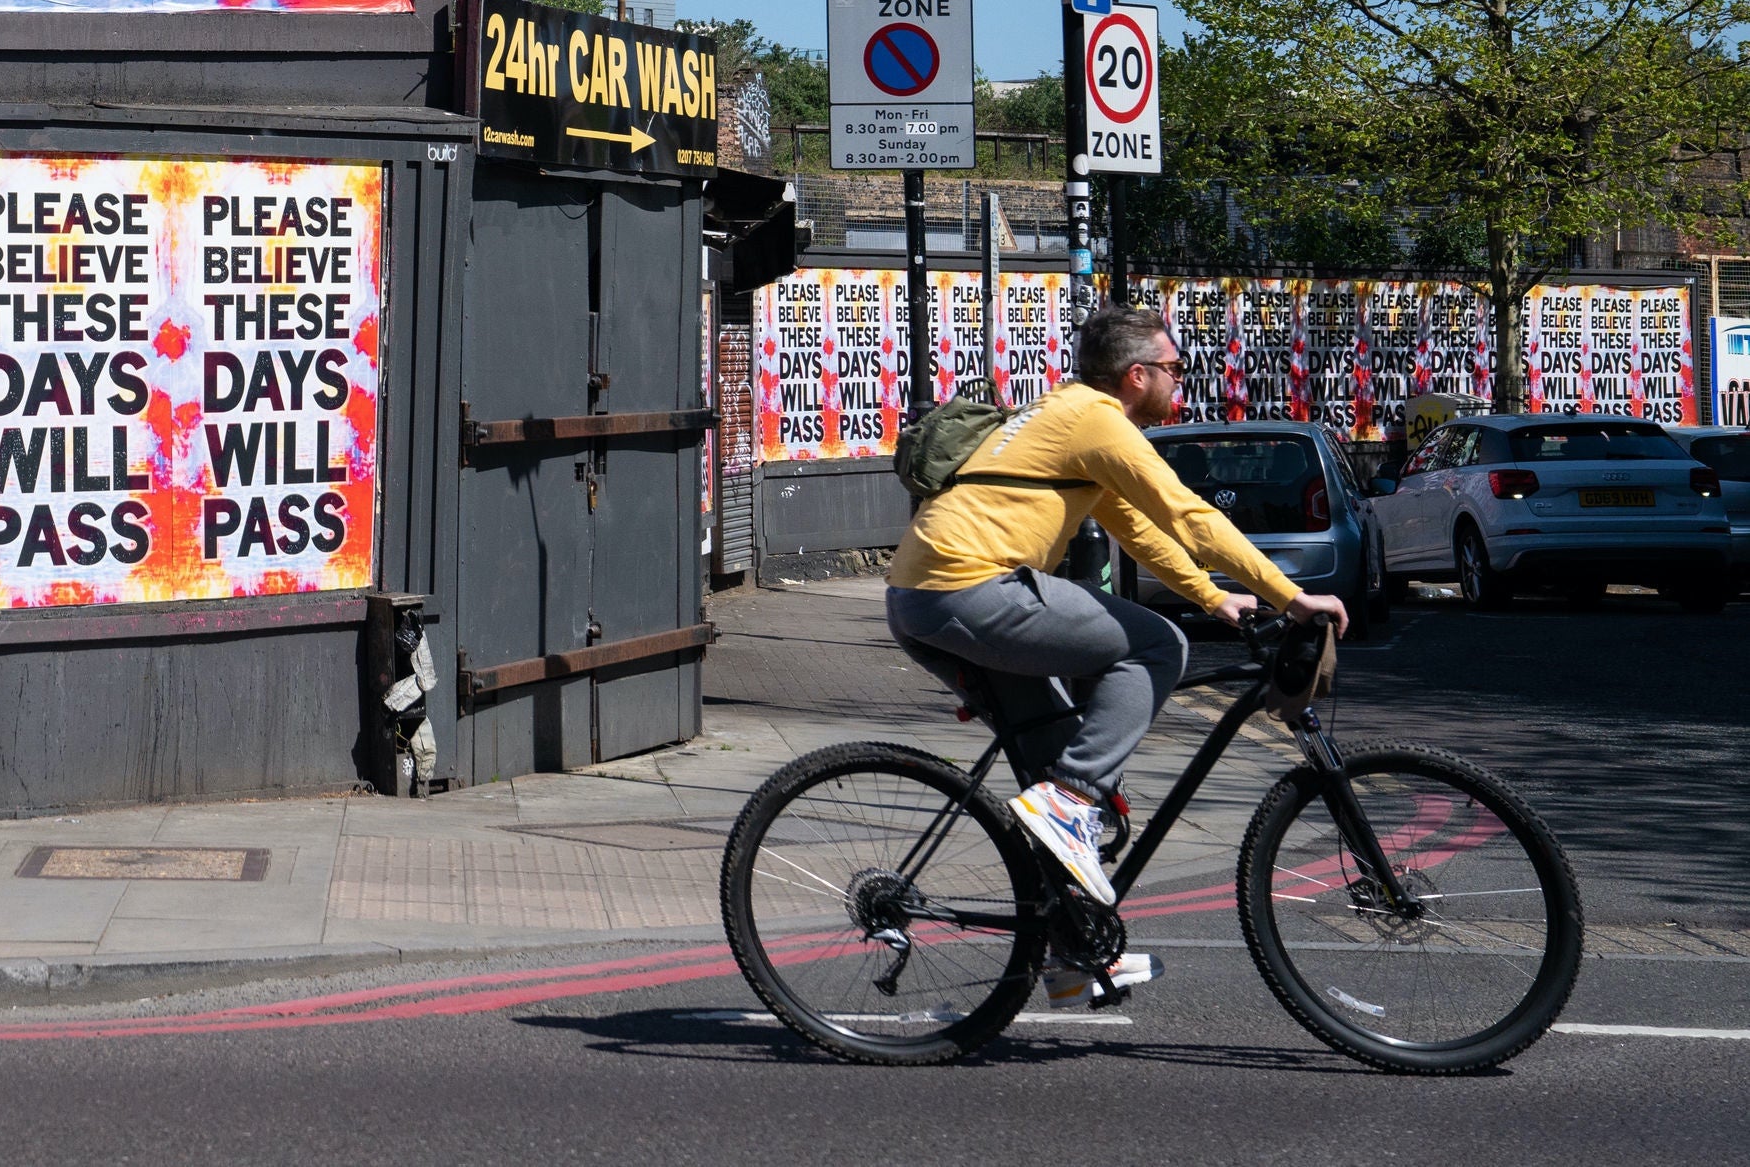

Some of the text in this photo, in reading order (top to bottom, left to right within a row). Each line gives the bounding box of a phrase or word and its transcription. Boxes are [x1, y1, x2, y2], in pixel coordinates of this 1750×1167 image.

[878, 0, 950, 17] ZONE
[485, 13, 560, 98] 24hr
[568, 29, 631, 109] CAR
[636, 41, 716, 120] WASH
[1097, 44, 1143, 90] 20
[845, 123, 877, 135] 8.30
[878, 125, 897, 134] am
[907, 123, 936, 134] 7.00
[939, 125, 959, 135] pm
[427, 143, 457, 162] build
[878, 139, 927, 151] Sunday
[1092, 131, 1153, 160] ZONE
[845, 153, 877, 164] 8.30
[879, 155, 898, 164] am
[906, 153, 938, 164] 2.00
[940, 155, 960, 165] pm
[204, 196, 351, 237] PLEASE
[204, 247, 351, 283] BELIEVE
[778, 284, 820, 302] PLEASE
[836, 284, 879, 302] PLEASE
[1008, 288, 1045, 303] PLEASE
[1129, 290, 1160, 305] EASE
[1178, 291, 1225, 307] PLEASE
[1243, 292, 1290, 307] PLEASE
[1308, 293, 1355, 308] PLEASE
[1373, 294, 1418, 309] PLEASE
[1433, 295, 1475, 310] PLEASE
[1542, 297, 1581, 311] PLEASE
[1592, 298, 1632, 312] PLEASE
[1641, 298, 1680, 312] PLEASE
[205, 294, 350, 340] THESE
[779, 306, 821, 322] BELIEVE
[837, 307, 879, 322] BELIEVE
[954, 307, 981, 322] BELIE
[1008, 308, 1045, 322] BELIEVE
[1178, 311, 1226, 325] BELIEVE
[1244, 312, 1290, 325] BELIEVE
[1308, 312, 1355, 326] BELIEVE
[1372, 313, 1417, 326] BELIEVE
[1432, 313, 1475, 327] BELIEVE
[1542, 315, 1581, 328] BELIEVE
[1591, 316, 1631, 329] BELIEVE
[1641, 316, 1680, 328] BELIEVE
[780, 327, 821, 347] THESE
[838, 327, 880, 347] THESE
[1009, 327, 1045, 345] THESE
[1178, 329, 1225, 347] THESE
[1244, 330, 1291, 347] THESE
[1308, 330, 1355, 347] THESE
[1372, 331, 1417, 347] THESE
[1433, 331, 1475, 348] THESE
[1542, 332, 1581, 348] THESE
[1592, 333, 1631, 348] THESE
[1641, 333, 1680, 348] THESE
[780, 351, 822, 379] DAYS
[838, 351, 881, 378] DAYS
[1010, 350, 1046, 374] DAYS
[1181, 351, 1226, 374] DAYS
[1245, 351, 1291, 374] DAYS
[1309, 351, 1355, 374] DAYS
[1372, 351, 1416, 374] DAYS
[1432, 351, 1475, 373] DAYS
[1542, 352, 1582, 373] DAYS
[1592, 353, 1631, 374] DAYS
[1641, 353, 1681, 373] DAYS
[204, 349, 348, 412] DAYS
[1246, 378, 1292, 401] WILL
[1311, 378, 1355, 401] WILL
[1542, 378, 1582, 399] WILL
[1593, 378, 1632, 399] WILL
[1643, 378, 1682, 399] WILL
[781, 384, 823, 412] WILL
[839, 383, 882, 410] WILL
[1181, 378, 1227, 402] WILL
[1311, 405, 1356, 427] PASS
[1373, 405, 1405, 427] PAS
[1643, 402, 1683, 422] PASS
[780, 415, 824, 443] PASS
[840, 414, 883, 440] PASS
[205, 421, 346, 487] WILL
[205, 493, 344, 558] PASS
